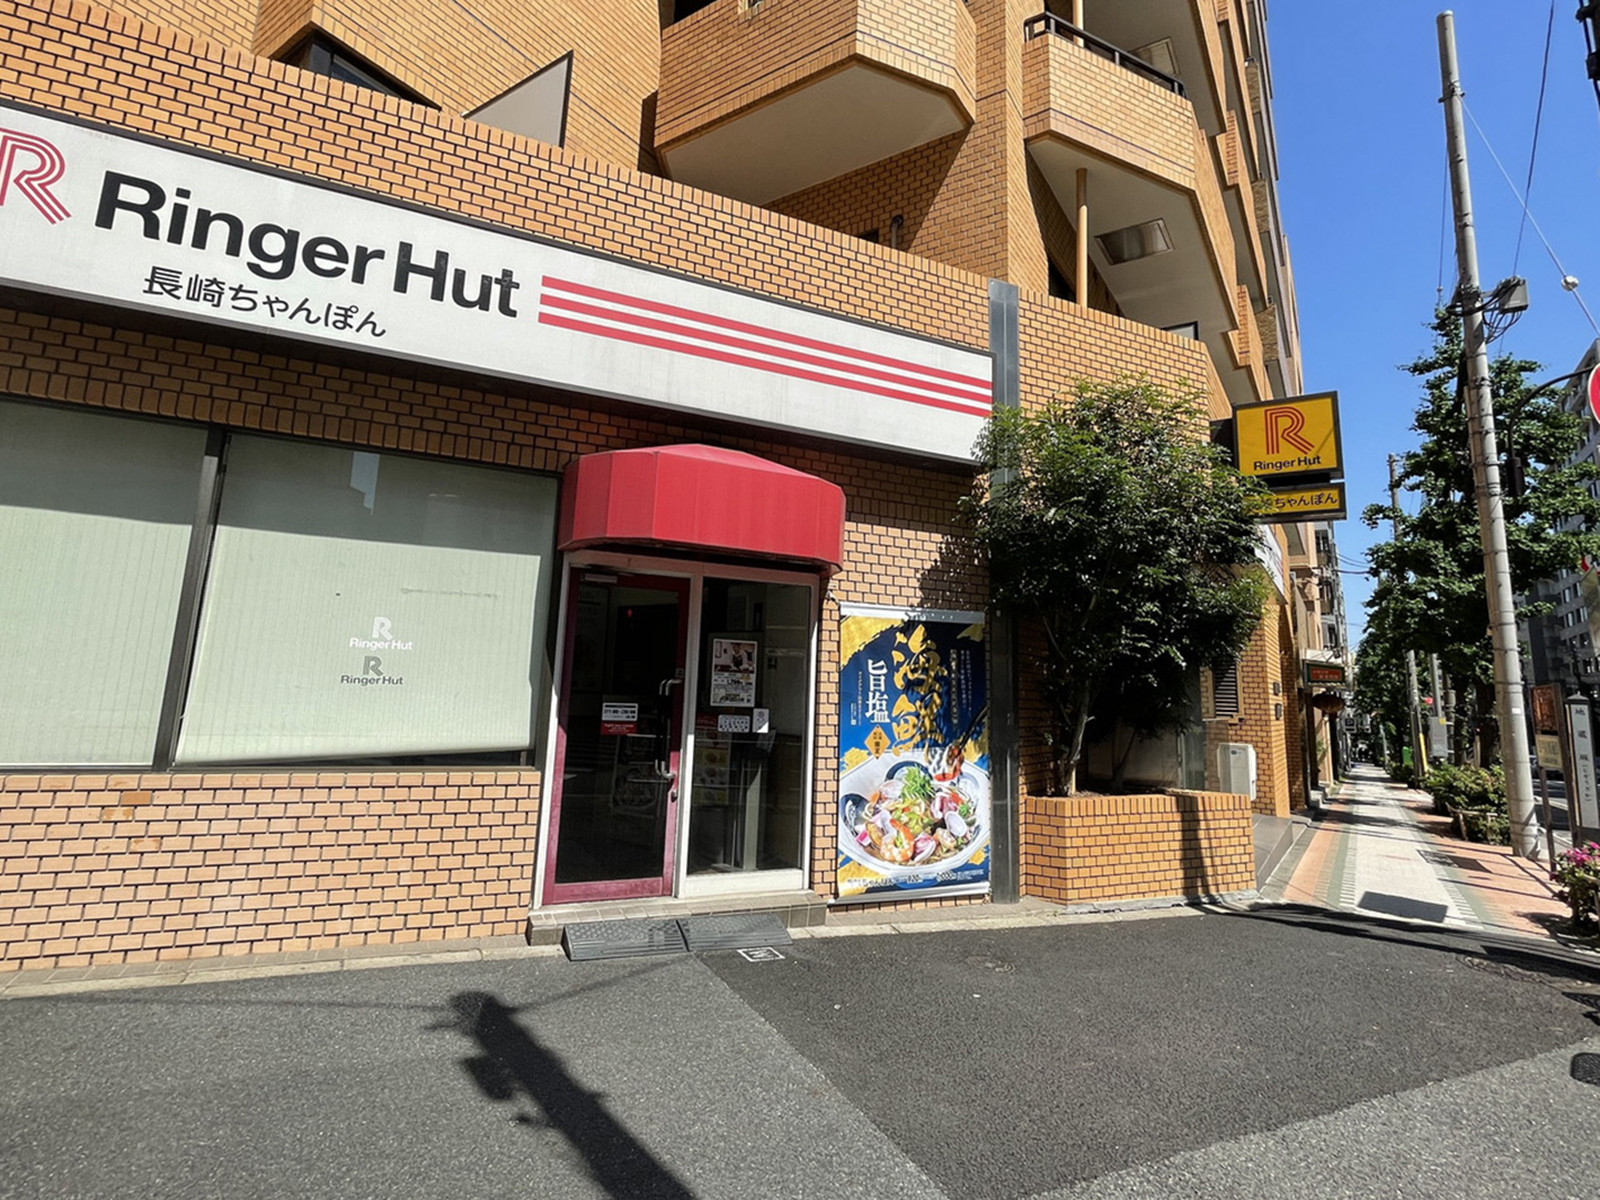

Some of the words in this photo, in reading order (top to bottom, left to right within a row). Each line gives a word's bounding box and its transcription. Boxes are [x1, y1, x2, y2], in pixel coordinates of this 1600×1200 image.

[95, 170, 385, 284] Ringer
[393, 241, 521, 318] Hut
[142, 264, 387, 338] 長崎ちゃんぽん
[1264, 406, 1315, 455] R
[1253, 459, 1296, 471] Ringer
[1297, 455, 1322, 467] Hut
[1260, 492, 1338, 510] ちゃんぽん
[372, 616, 393, 640] R
[349, 636, 390, 651] Ringer
[391, 639, 414, 650] Hut
[340, 674, 382, 687] Ringer
[382, 675, 404, 686] Hut
[864, 658, 891, 724] 旨塩
